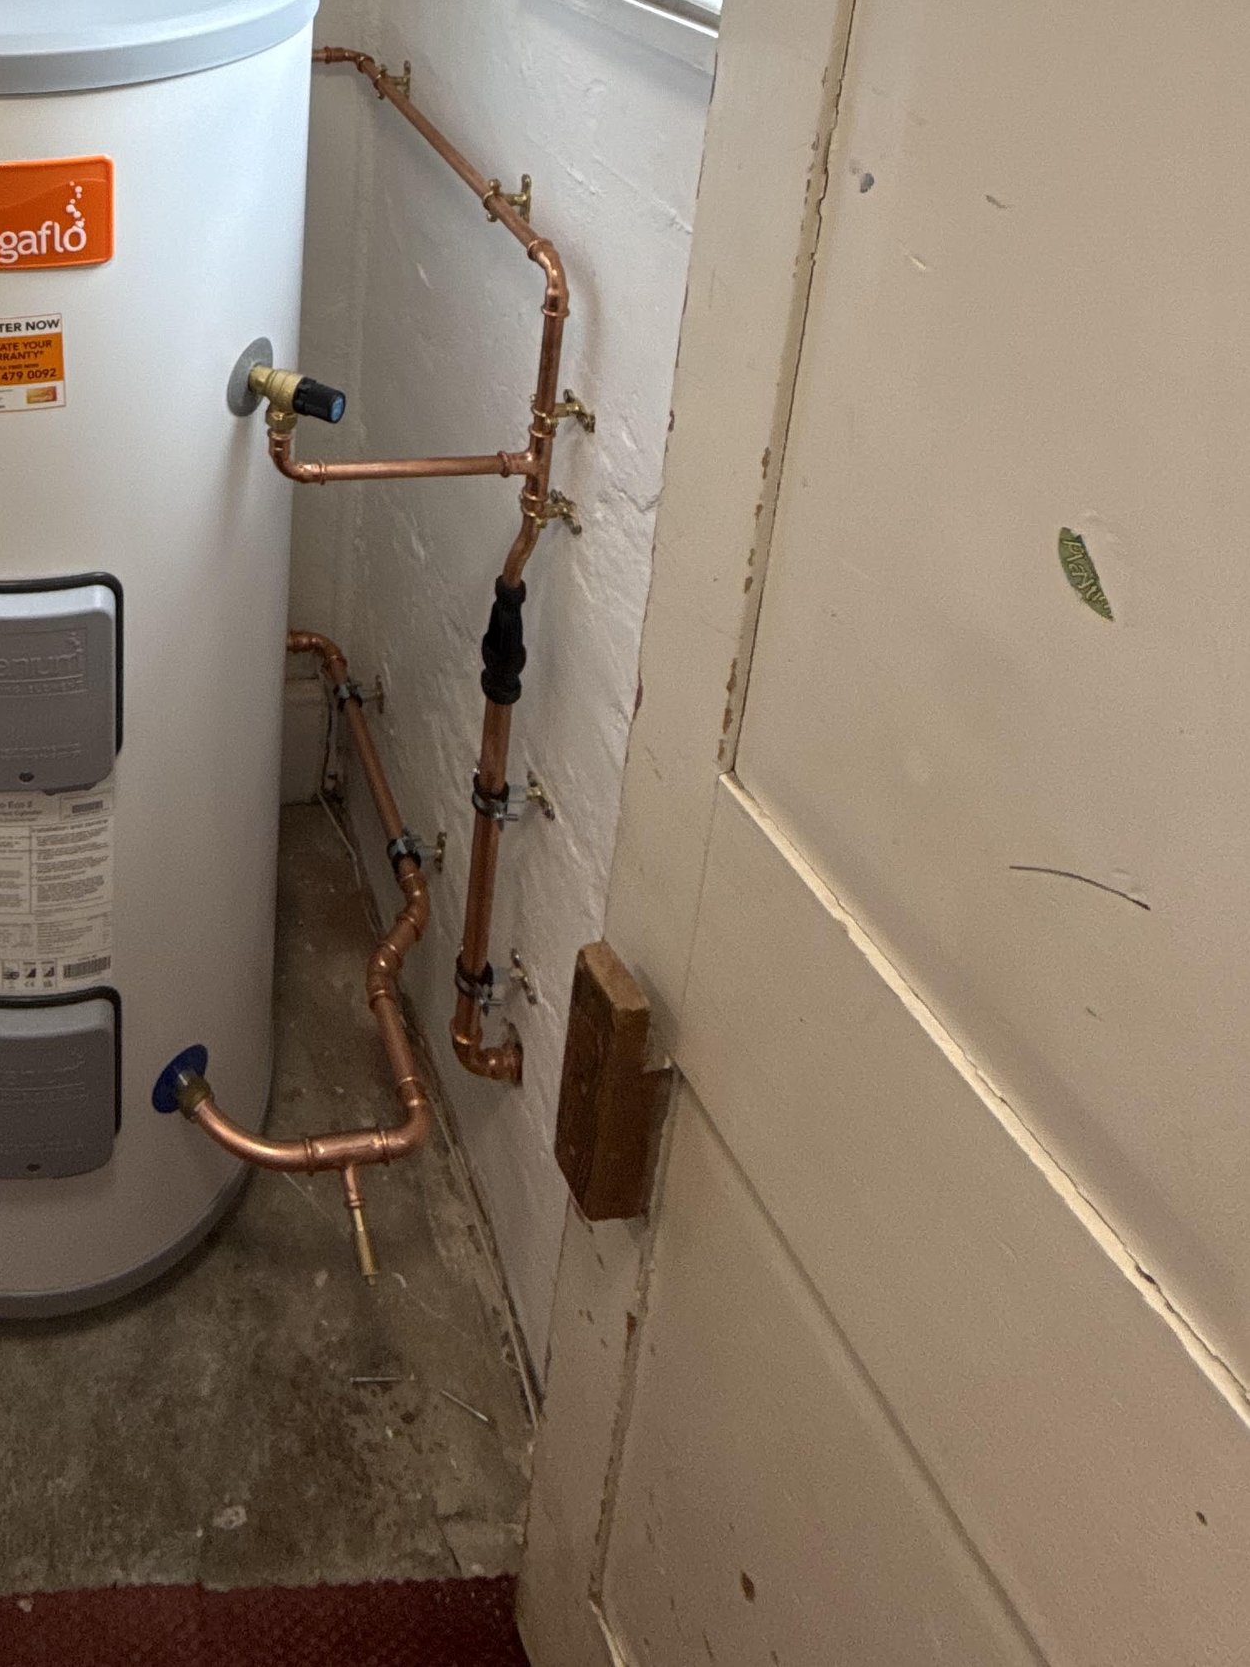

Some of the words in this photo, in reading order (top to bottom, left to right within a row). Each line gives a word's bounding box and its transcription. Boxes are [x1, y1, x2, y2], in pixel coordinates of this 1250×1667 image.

[25, 319, 60, 331] NOW
[22, 340, 52, 350] YOUR
[1, 371, 24, 381] 479
[27, 368, 57, 379] 0092
